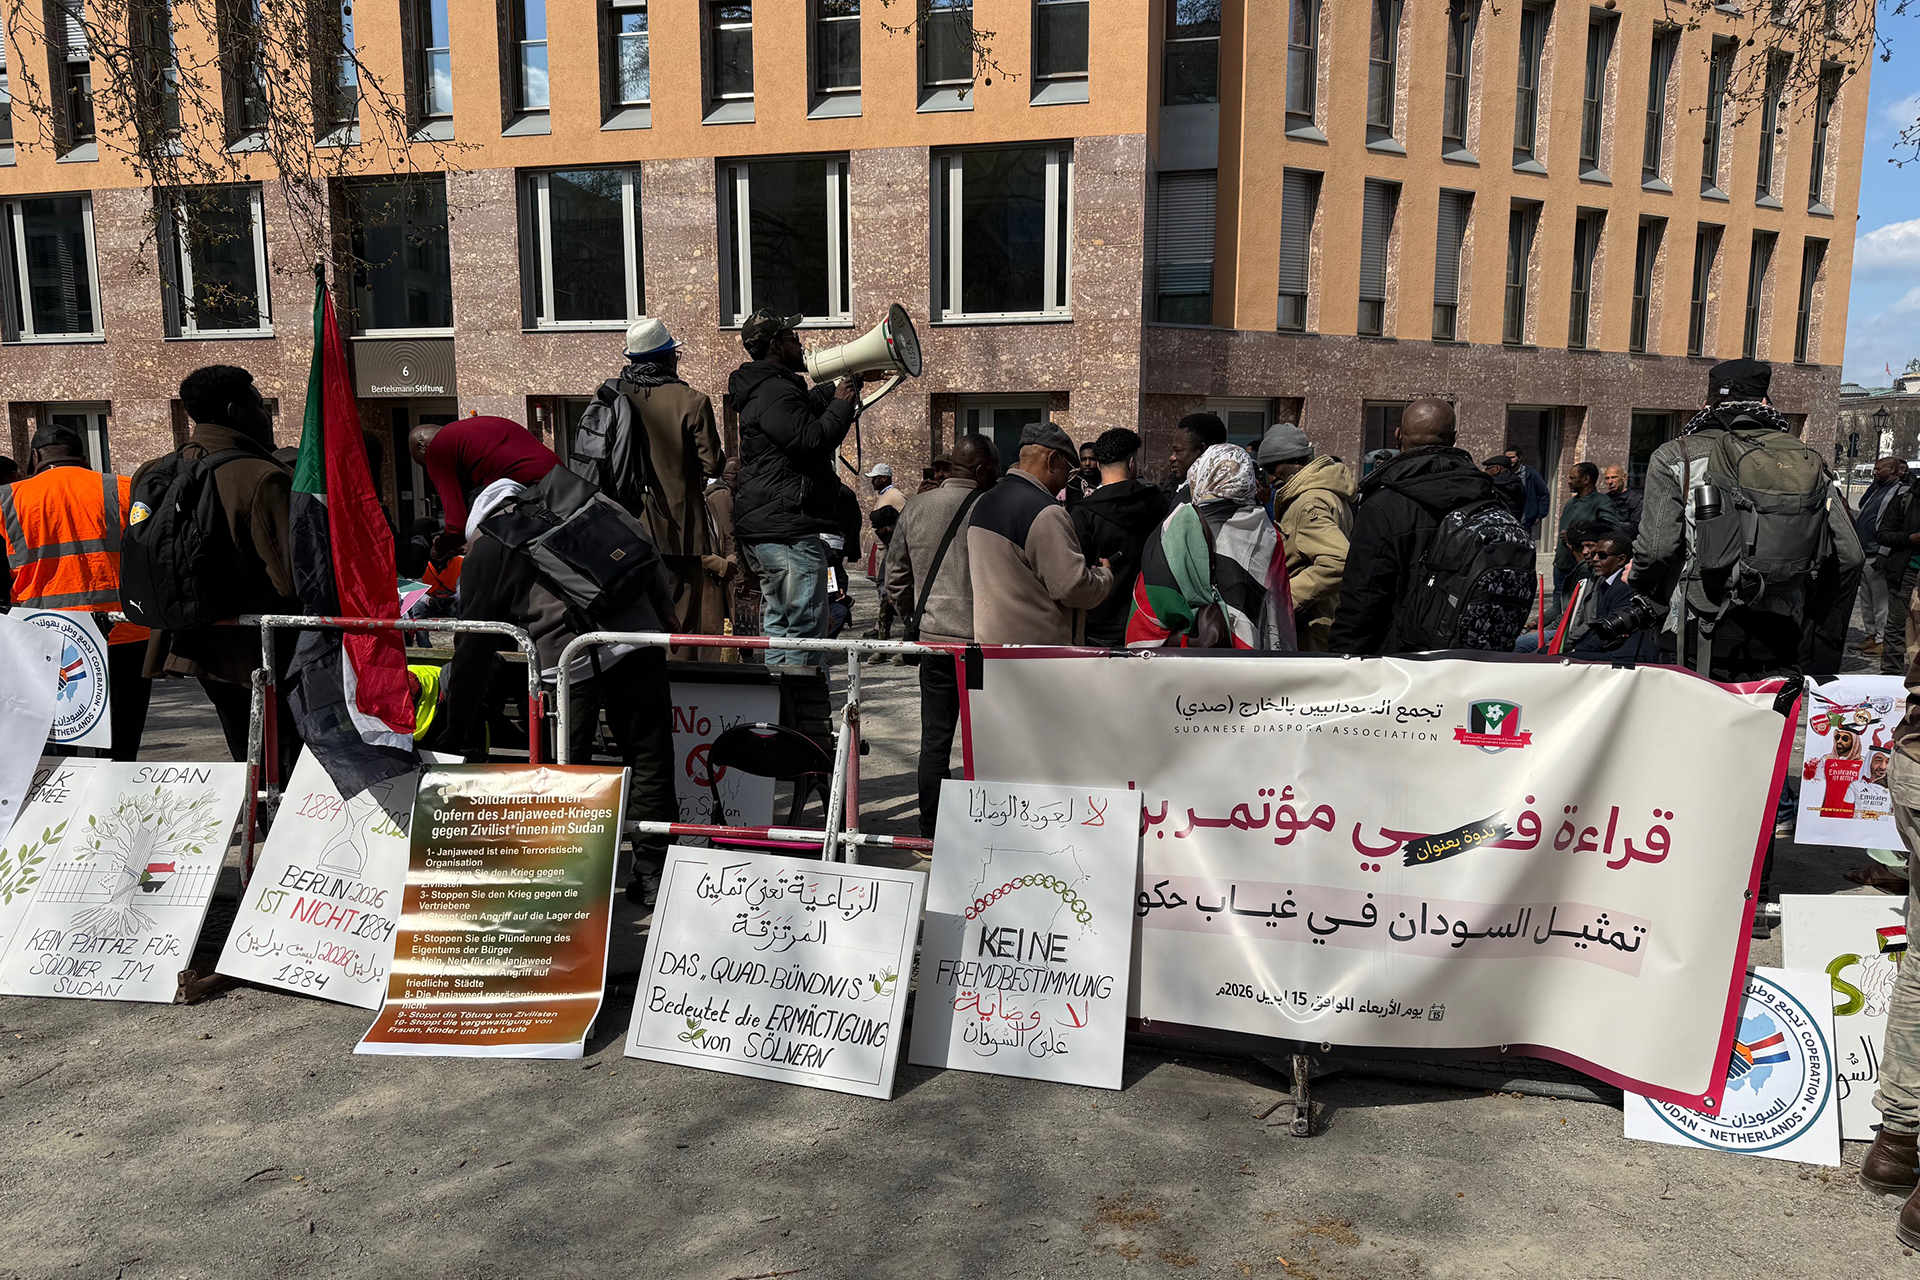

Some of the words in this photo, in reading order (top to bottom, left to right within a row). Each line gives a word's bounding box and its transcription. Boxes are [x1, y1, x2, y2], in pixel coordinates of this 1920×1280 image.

[402, 366, 409, 377] 6
[371, 385, 415, 393] Bertelsmann
[415, 384, 444, 394] Stiftung
[61, 623, 78, 638] وطن
[76, 634, 94, 654] تجمع
[92, 655, 103, 707] COPERATION
[58, 703, 87, 726] السودان
[1175, 694, 1234, 721] (صدي)
[1238, 696, 1295, 717] بالخارج
[1395, 703, 1444, 723] تجمع
[671, 706, 711, 736] No
[1174, 725, 1246, 734] SUDANESE
[1253, 724, 1323, 733] DIASPORA
[1332, 726, 1438, 742] ASSOCIATION
[132, 767, 211, 784] SUDAN
[1828, 768, 1858, 777] Emirates
[24, 785, 71, 803] RMEE
[469, 793, 533, 806] Solidarität
[535, 793, 556, 804] mit
[558, 792, 581, 804] den
[1860, 794, 1888, 802] Emirates
[295, 792, 345, 822] 1884
[371, 808, 411, 839] 202
[433, 809, 475, 823] Opfern
[477, 808, 499, 820] des
[500, 806, 613, 822] Janjaweed-Krieges
[1175, 784, 1337, 846] مؤتمر
[431, 825, 468, 840] gegen
[551, 823, 565, 835] im
[567, 822, 605, 834] Sudan
[1351, 794, 1543, 873] في
[1462, 823, 1496, 846] ندوة
[1553, 804, 1674, 871] قراءة
[426, 848, 435, 856] 1-
[437, 846, 485, 858] Janjaweed
[486, 846, 499, 855] ist
[500, 846, 519, 855] eine
[521, 845, 583, 855] Terroristische
[1415, 836, 1461, 862] بعنوان
[425, 858, 483, 868] Organisation
[474, 868, 489, 878] Sie
[491, 868, 508, 877] den
[510, 868, 535, 879] Krieg
[536, 868, 565, 879] gegen
[278, 864, 352, 901] BERLIN
[348, 882, 389, 909] 2026
[419, 890, 429, 899] 3-
[431, 890, 469, 901] Stoppen
[471, 890, 486, 898] Sie
[488, 890, 505, 898] den
[507, 890, 532, 900] Krieg
[534, 890, 562, 900] gegen
[564, 889, 579, 898] die
[255, 887, 290, 915] IST
[289, 897, 360, 933] NICHT
[351, 913, 396, 943] 1884
[419, 902, 471, 910] Vertriebene
[1195, 884, 1298, 928] غياب
[463, 912, 478, 921] den
[479, 911, 511, 922] Angriff
[513, 911, 529, 920] auf
[530, 911, 544, 920] die
[546, 911, 573, 922] Lager
[574, 911, 590, 920] der
[1307, 892, 1378, 945] في
[1388, 902, 1533, 949] السودان
[413, 934, 422, 943] 5-
[424, 934, 462, 945] Stoppen
[464, 934, 480, 943] Sie
[481, 934, 496, 943] die
[498, 933, 552, 944] Plünderung
[554, 933, 571, 942] des
[1533, 906, 1647, 953] تمثيل
[24, 927, 69, 951] KEIN
[142, 933, 180, 957] FÜR
[235, 925, 284, 958] برلين
[411, 945, 461, 955] Eigentums
[463, 945, 479, 954] der
[480, 945, 513, 955] Bürger
[978, 926, 1068, 964] KEINE
[318, 942, 352, 967] 2026
[447, 957, 469, 965] Nein
[470, 956, 485, 965] für
[487, 957, 500, 965] die
[502, 956, 553, 968] Janjaweed
[658, 951, 700, 978] DAS
[30, 953, 102, 979] SÖLDNER
[110, 959, 155, 983] IM
[343, 949, 384, 984] برلين
[499, 967, 533, 979] Angriff
[535, 967, 550, 977] auf
[53, 976, 123, 998] SUDAN
[272, 964, 330, 991] 1884
[405, 979, 449, 988] friedliche
[454, 979, 484, 988] Städte
[936, 959, 1115, 1000] FREMDBESTIMMUNG
[404, 990, 414, 999] 8-
[415, 990, 431, 999] Die
[433, 991, 484, 1000] Janjaweed
[1215, 982, 1253, 998] 2026م
[1291, 991, 1308, 1005] 15
[1746, 982, 1776, 1004] وطن
[401, 1001, 428, 1010] nicht.
[1311, 995, 1354, 1013] الموافق
[1358, 998, 1401, 1018] الأربعاء
[1400, 1006, 1423, 1019] يوم
[1774, 999, 1808, 1029] تجمع
[409, 1011, 440, 1020] Stoppt
[442, 1011, 457, 1019] die
[460, 1011, 493, 1020] Tötung
[410, 1019, 444, 1027] Stoppt
[460, 1018, 533, 1028] vergewaltigung
[649, 986, 731, 1024] Bedeutet
[735, 1005, 760, 1028] die
[765, 1002, 889, 1048] ERMÄCTIGUNG
[387, 1026, 423, 1035] Frauen,
[426, 1026, 458, 1035] Kinder
[460, 1027, 479, 1035] und
[481, 1026, 499, 1035] alte
[500, 1025, 527, 1034] Leute
[701, 1035, 731, 1053] von
[744, 1031, 835, 1070] SÖLNERN
[1801, 1031, 1821, 1105] COPERATION
[1731, 1097, 1788, 1129] السودان
[1710, 1112, 1803, 1144] NETHERLANDS
